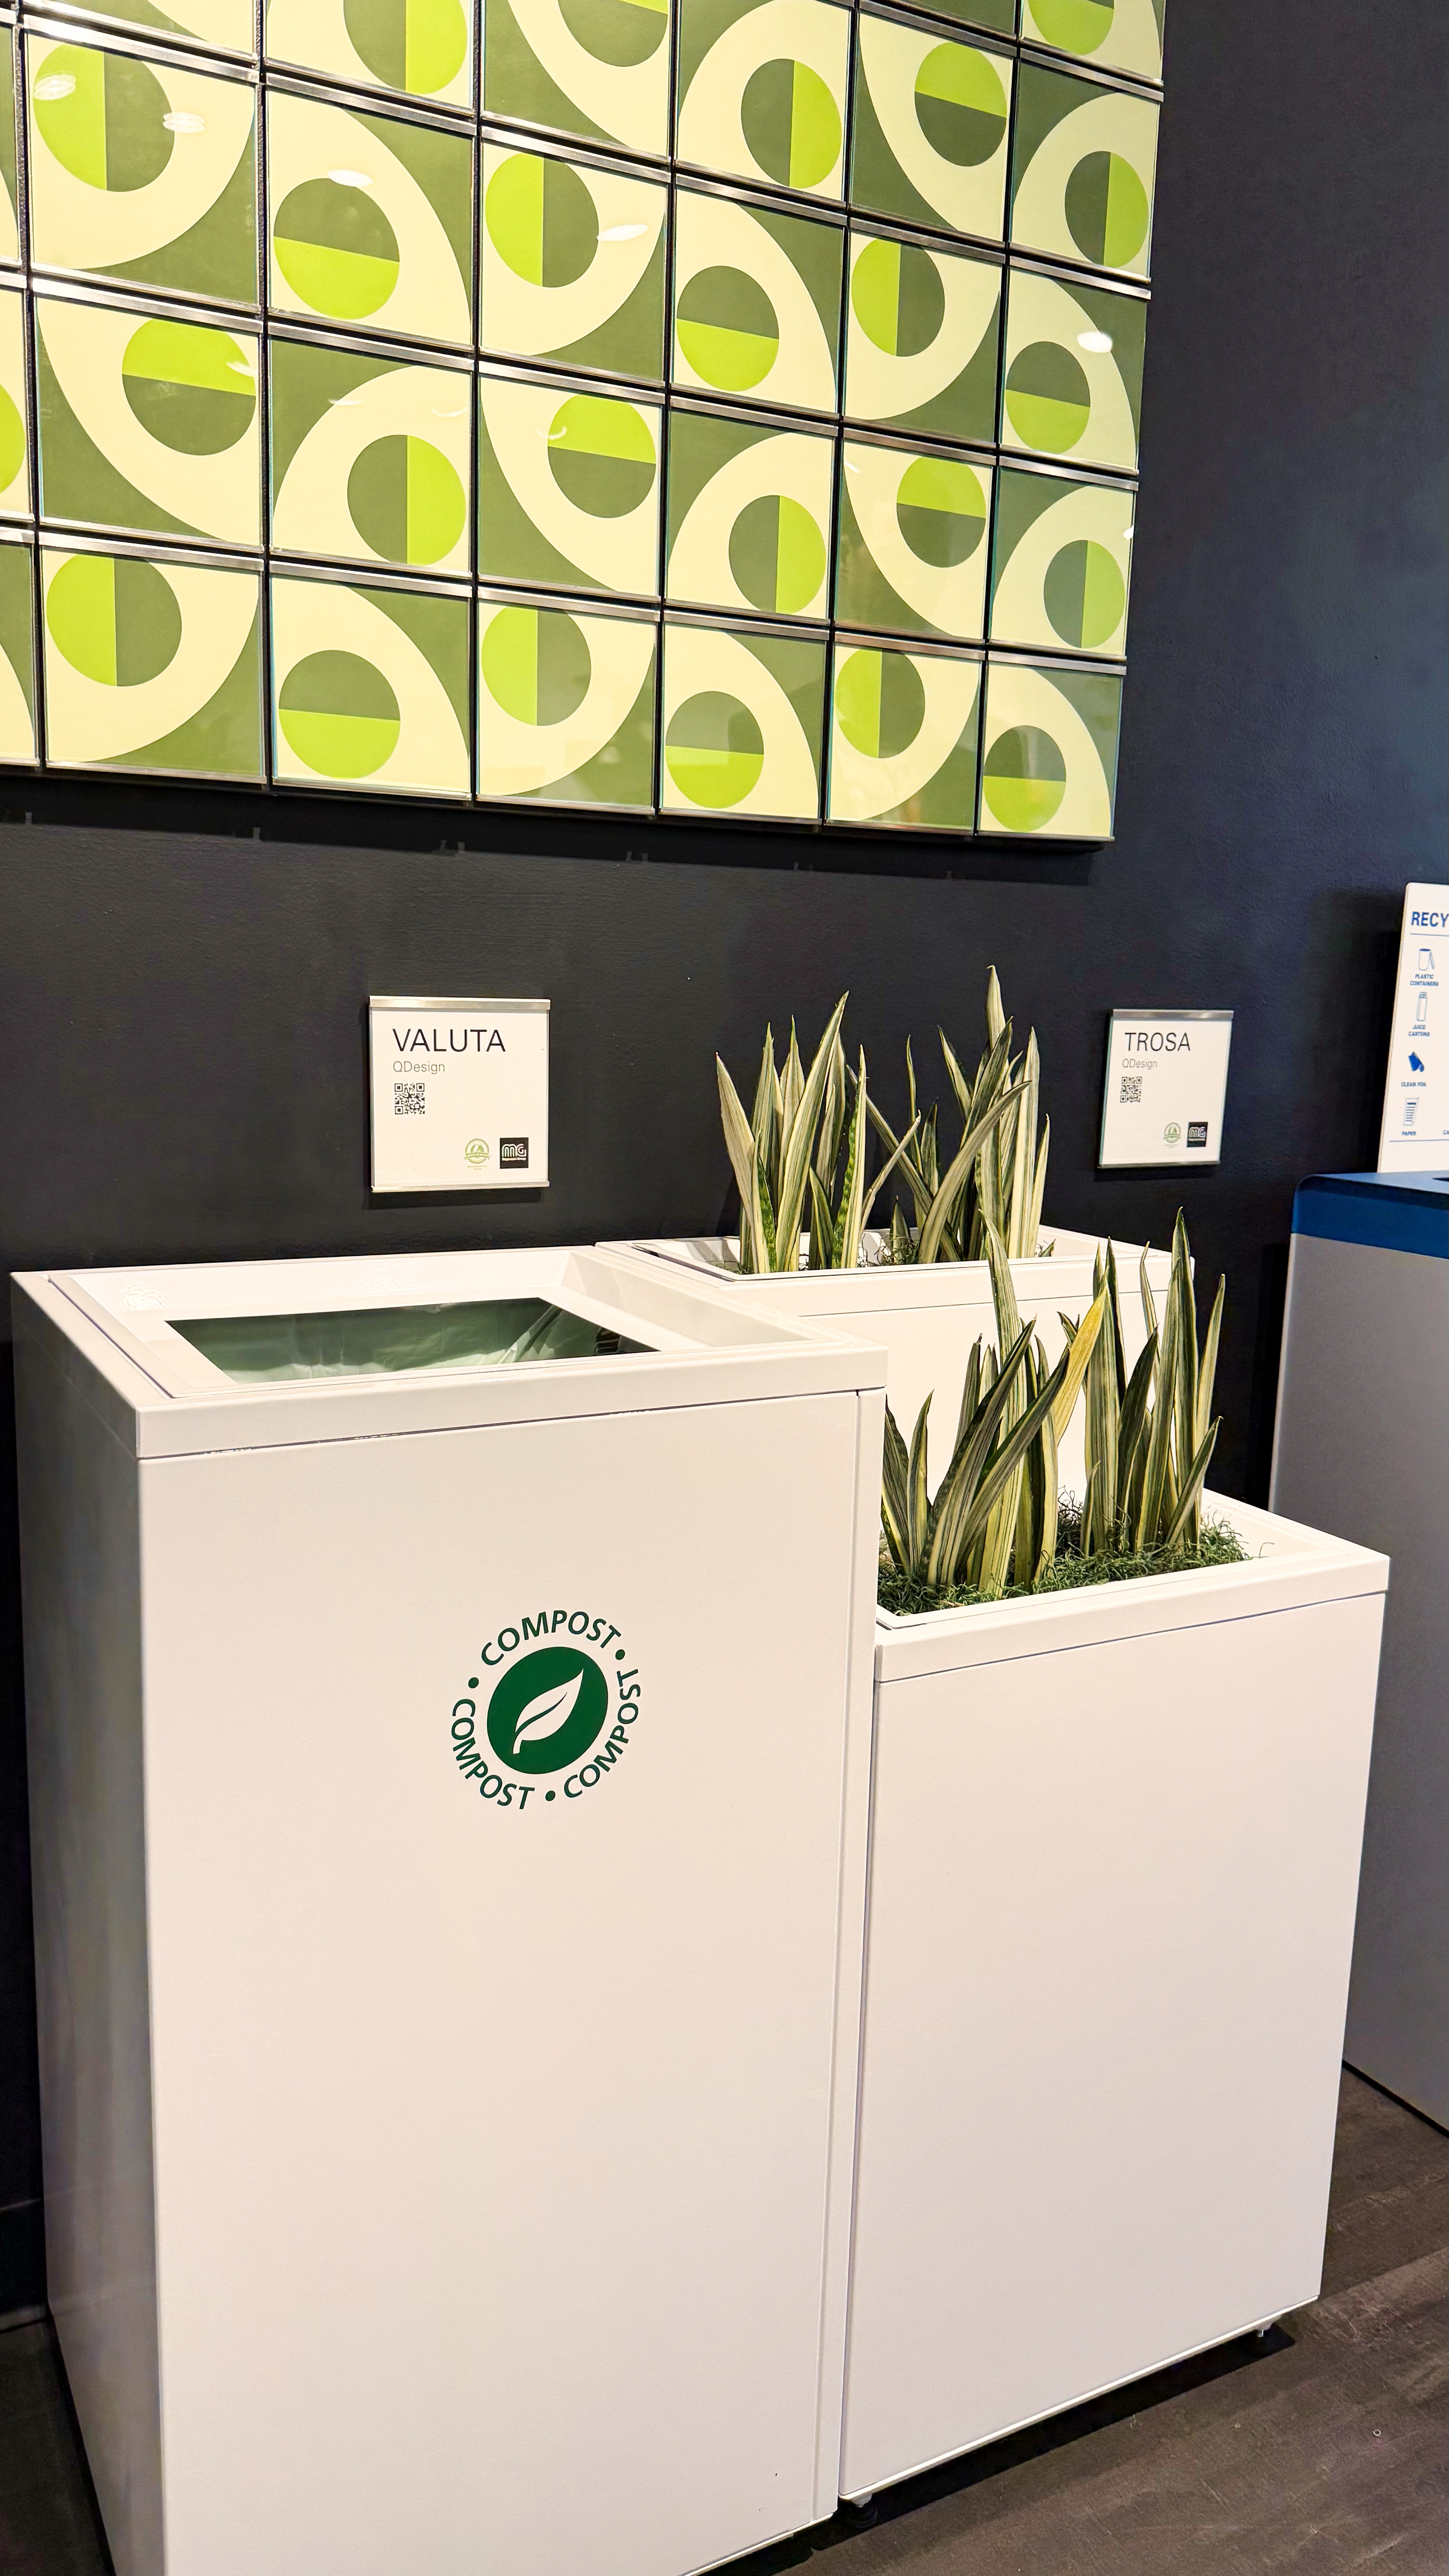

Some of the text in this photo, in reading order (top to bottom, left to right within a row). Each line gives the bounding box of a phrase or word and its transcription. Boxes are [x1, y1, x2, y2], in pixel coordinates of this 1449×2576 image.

[392, 1028, 506, 1052] VALUTA
[1124, 1032, 1191, 1052] TROSA
[393, 1061, 445, 1075] QDesign
[1122, 1058, 1157, 1070] QDesign
[481, 1610, 621, 1666] COMPOST
[564, 1669, 641, 1798] COMPOST
[451, 1698, 535, 1810] COMPOST
